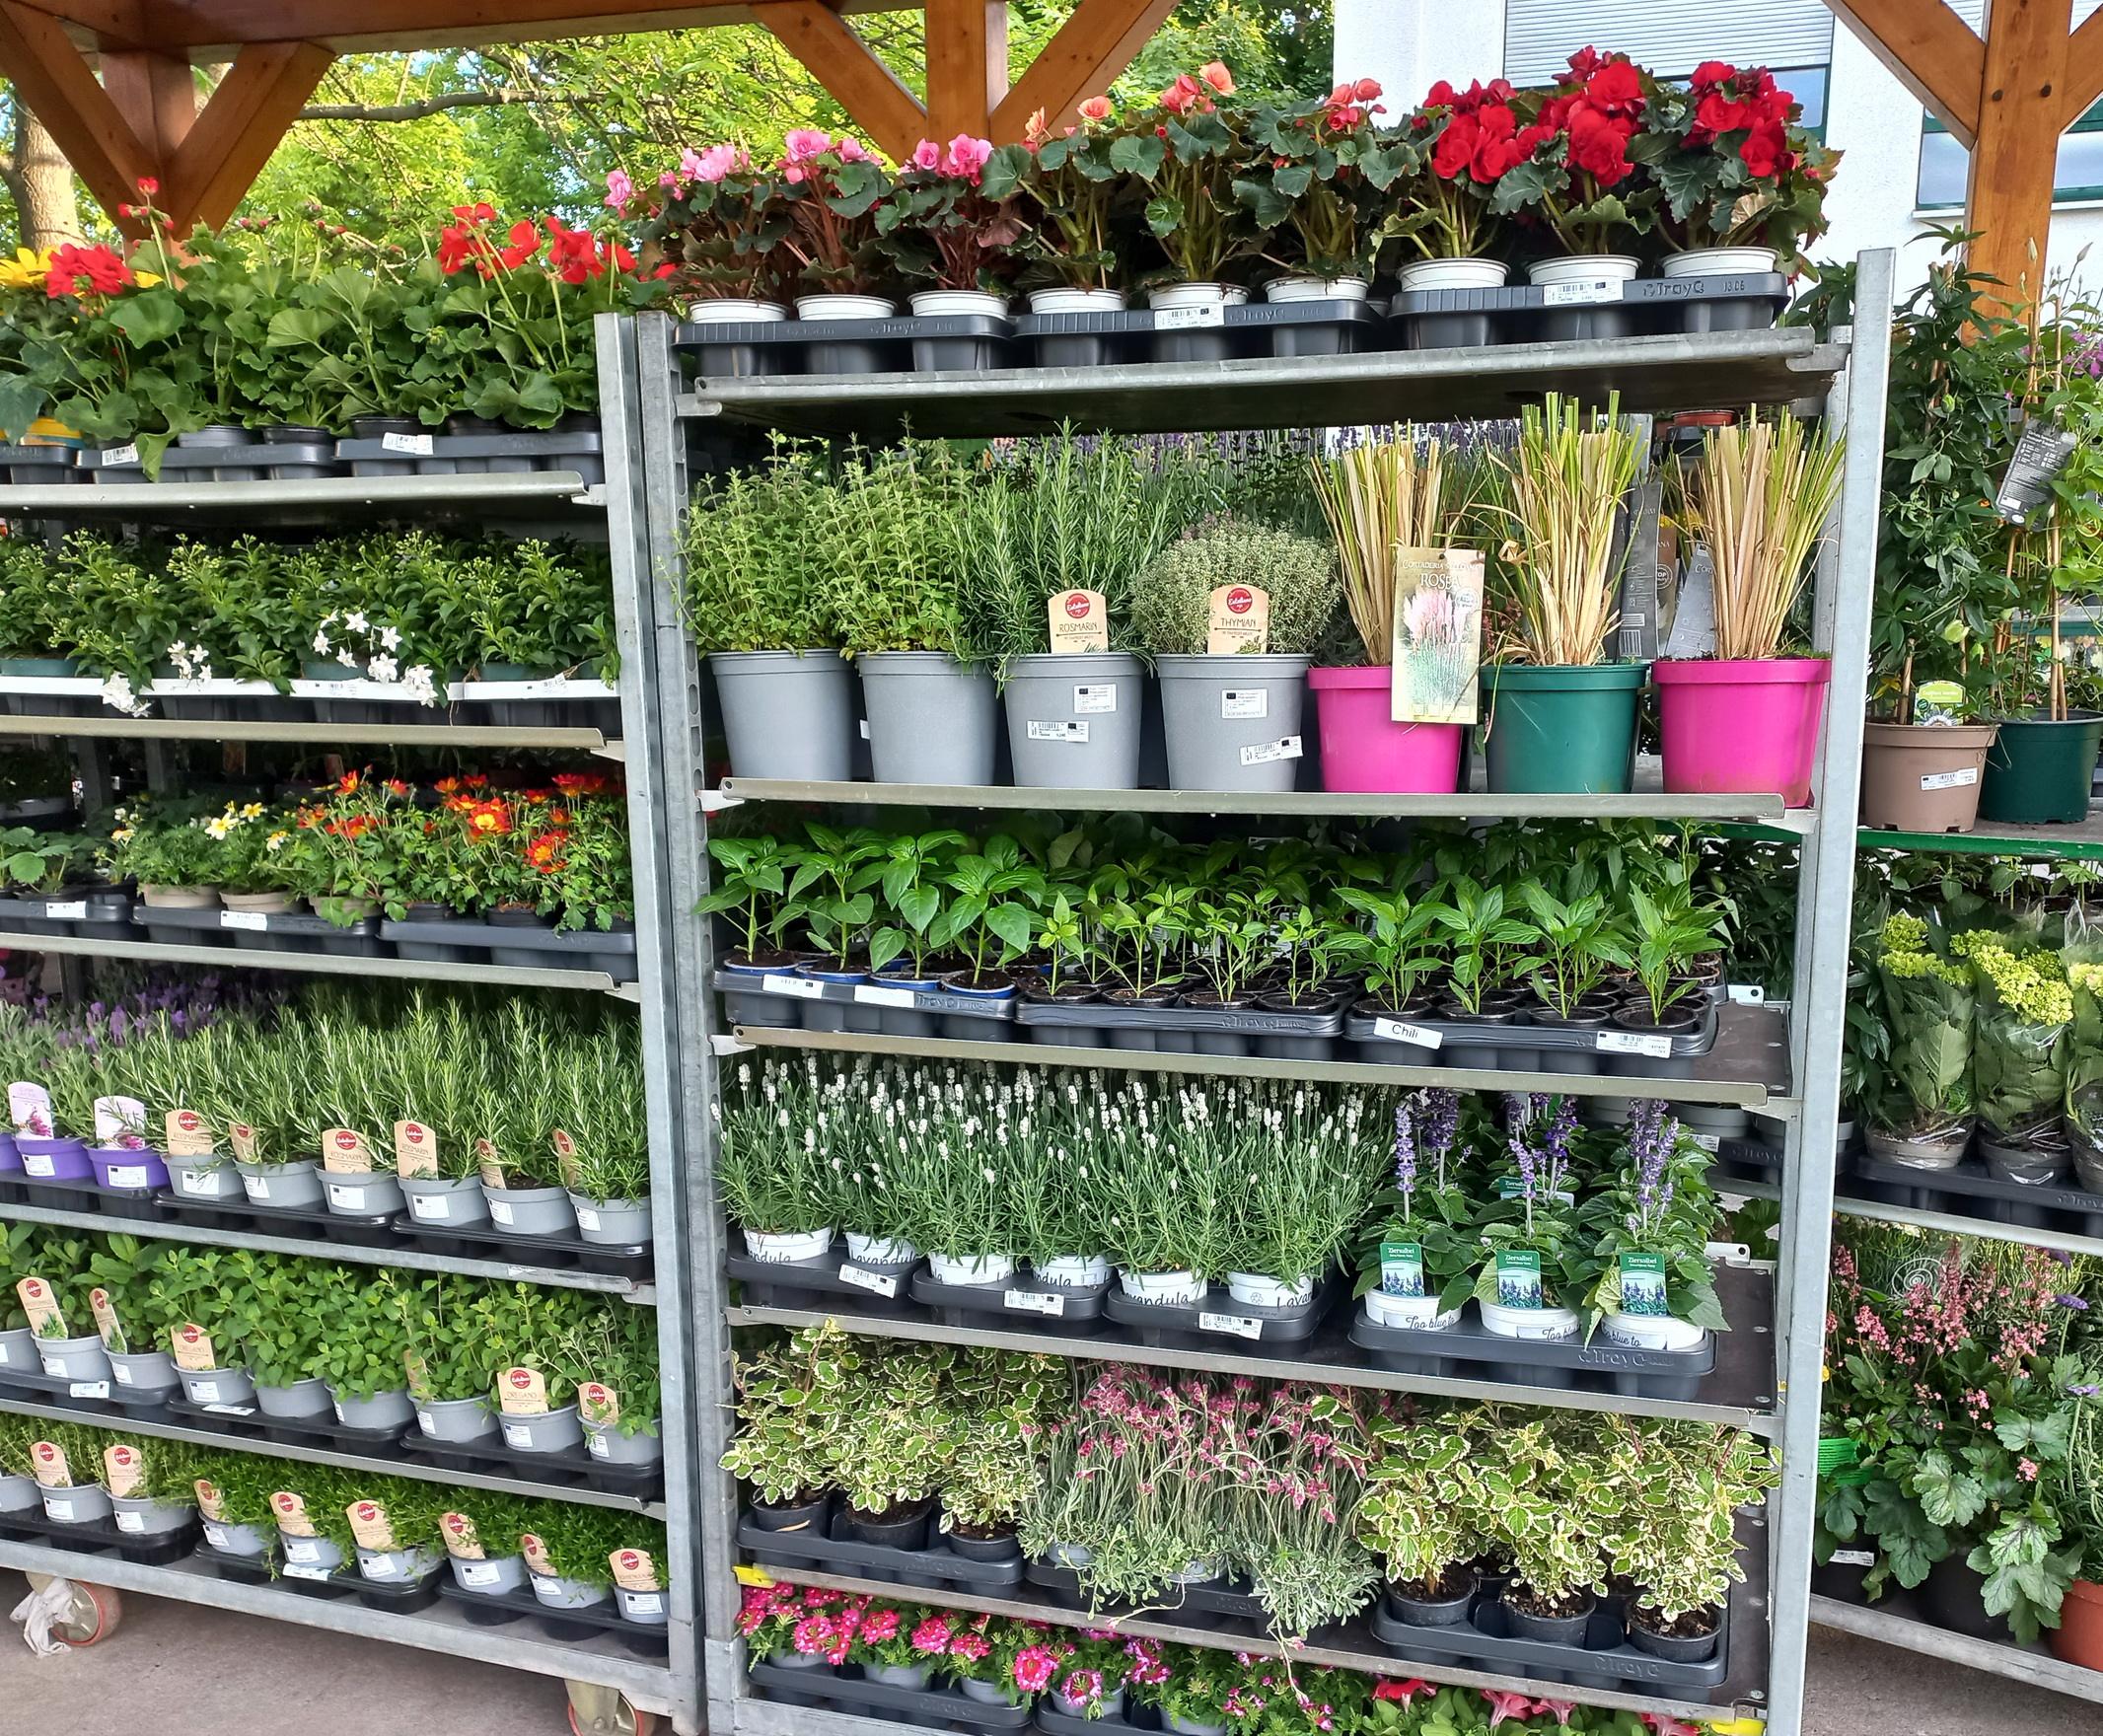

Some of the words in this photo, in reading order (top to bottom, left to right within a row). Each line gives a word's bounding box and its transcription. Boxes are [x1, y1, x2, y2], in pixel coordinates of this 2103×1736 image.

[1420, 572, 1461, 590] ROSEA
[1058, 621, 1098, 633] ROSMARIN
[1220, 617, 1257, 628] THYMIAN
[1392, 1024, 1419, 1039] Chili
[1406, 1315, 1427, 1331] Too
[1612, 1330, 1630, 1345] blue
[1631, 1335, 1642, 1347] to
